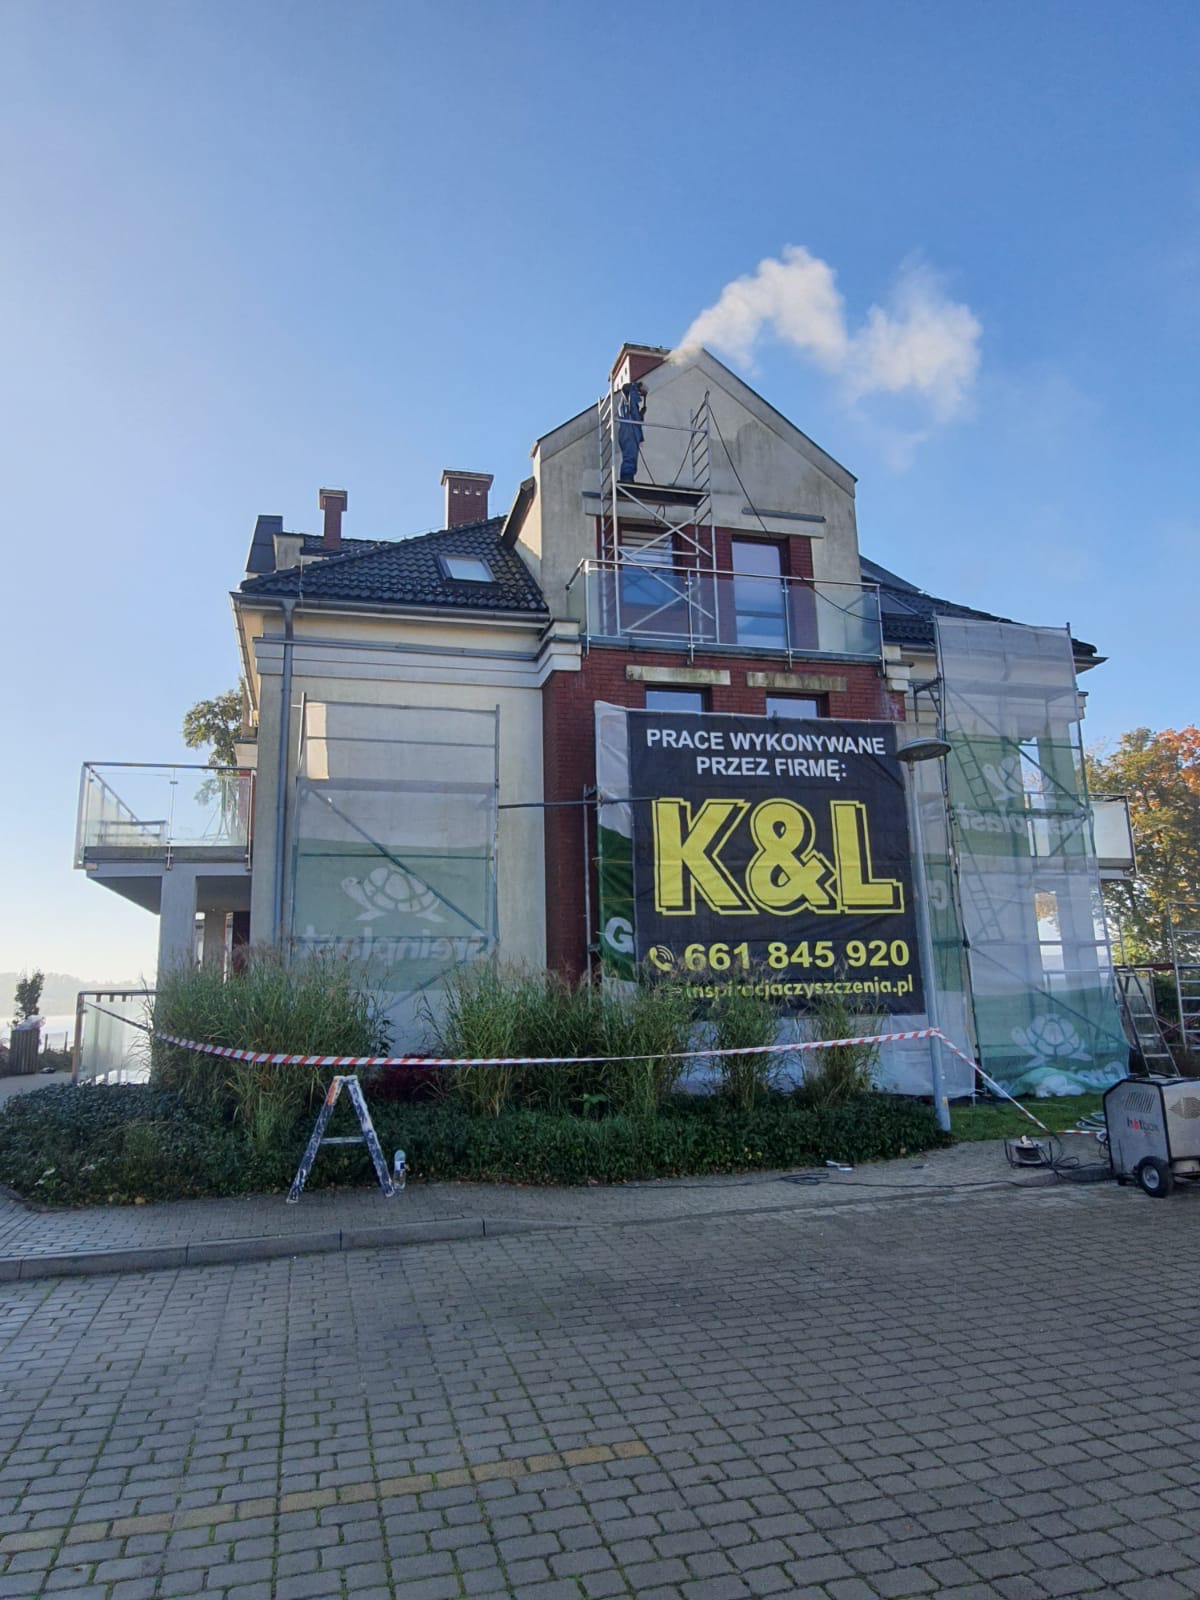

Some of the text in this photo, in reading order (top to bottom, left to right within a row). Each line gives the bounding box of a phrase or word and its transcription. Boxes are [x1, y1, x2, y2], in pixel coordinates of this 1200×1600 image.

[646, 729, 886, 755] PRACE WYKONYWANE
[696, 756, 847, 781] PRZEZ FIRMĘ:
[651, 797, 905, 916] K&L
[683, 940, 910, 971] 661 845 920
